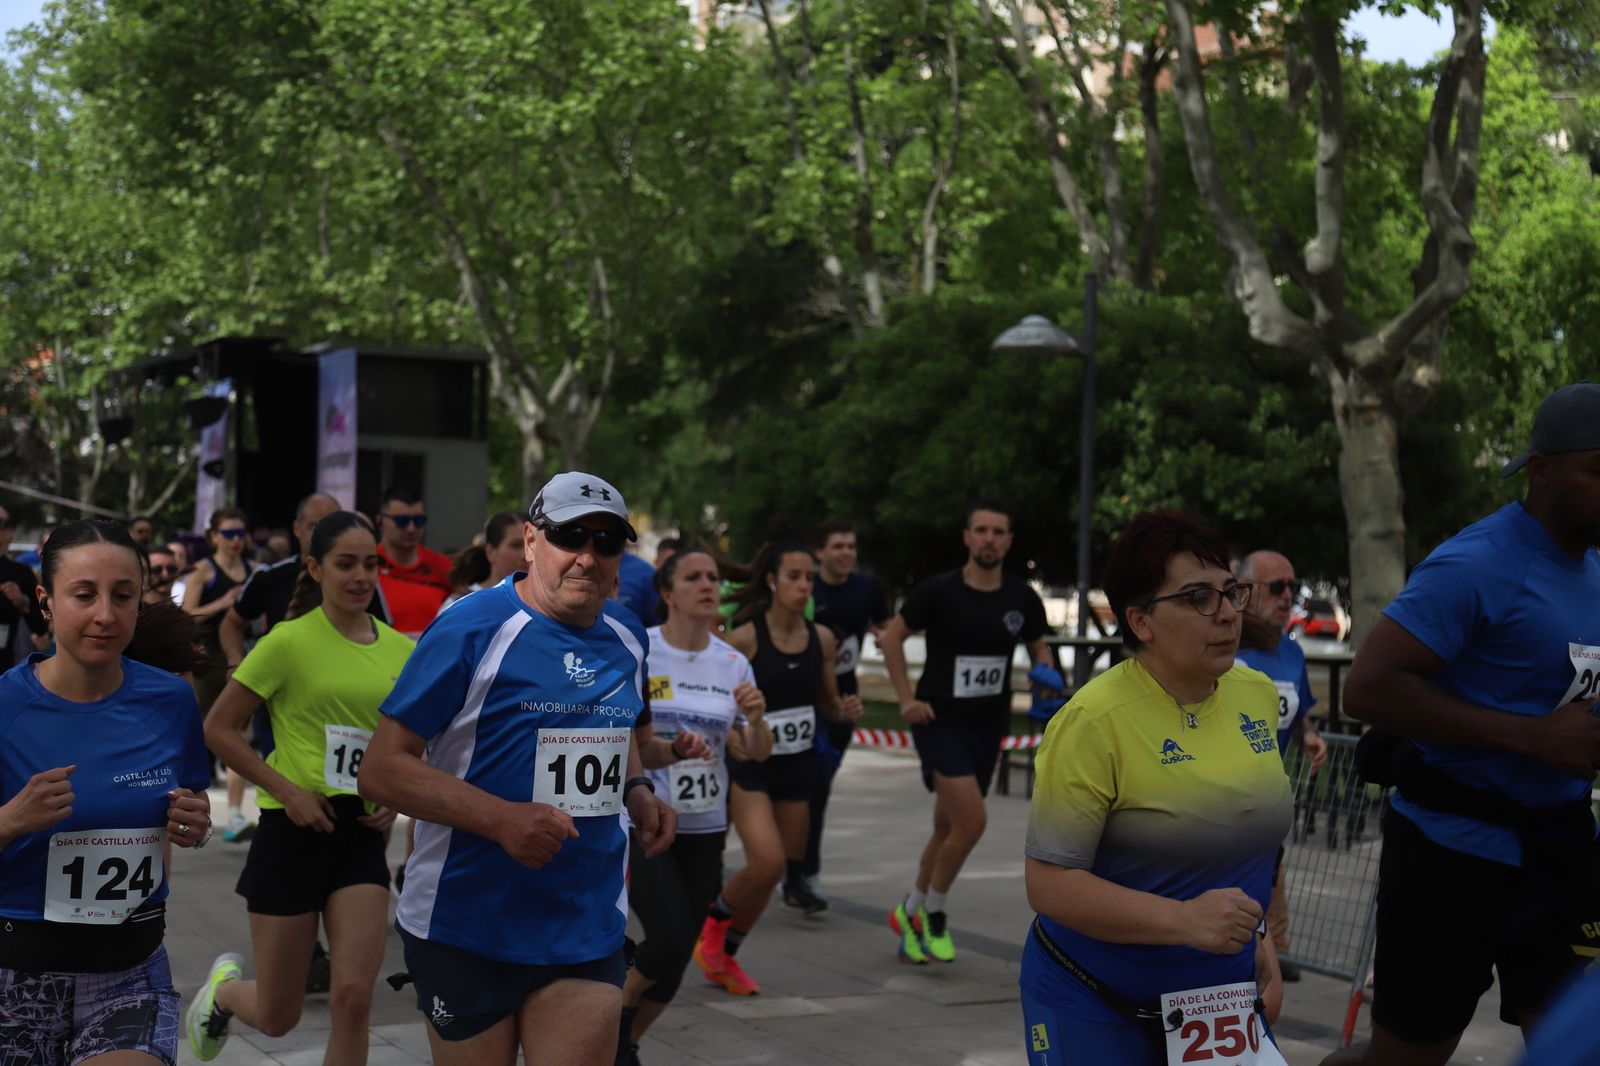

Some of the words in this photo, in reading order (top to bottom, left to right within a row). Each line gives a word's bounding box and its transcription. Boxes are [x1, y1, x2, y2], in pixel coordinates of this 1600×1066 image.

[962, 667, 1001, 687] 140
[520, 701, 591, 715] INMOBILIARIA
[593, 704, 635, 719] PROCASA
[1278, 695, 1289, 717] 3
[542, 735, 557, 744] DÍA
[558, 736, 570, 744] DE
[571, 736, 606, 744] CASTILLA
[612, 735, 627, 743] LEÓN
[772, 720, 812, 744] 192
[334, 744, 365, 778] 18
[113, 771, 152, 783] CASTILLA
[153, 769, 159, 778] Y
[547, 754, 621, 796] 104
[677, 773, 720, 800] 213
[56, 835, 74, 847] DÍA
[75, 838, 89, 846] DE
[91, 836, 133, 846] CASTILLA
[135, 837, 142, 846] Y
[141, 834, 160, 845] LEÓN
[62, 855, 155, 901] 124
[1169, 994, 1186, 1008] DÍA
[1188, 995, 1201, 1004] DE
[1203, 993, 1215, 1002] LA
[1185, 1003, 1229, 1017] CASTILLA
[1231, 1002, 1237, 1010] Y
[1240, 998, 1255, 1009] LEÓ
[1180, 1012, 1259, 1063] 250
